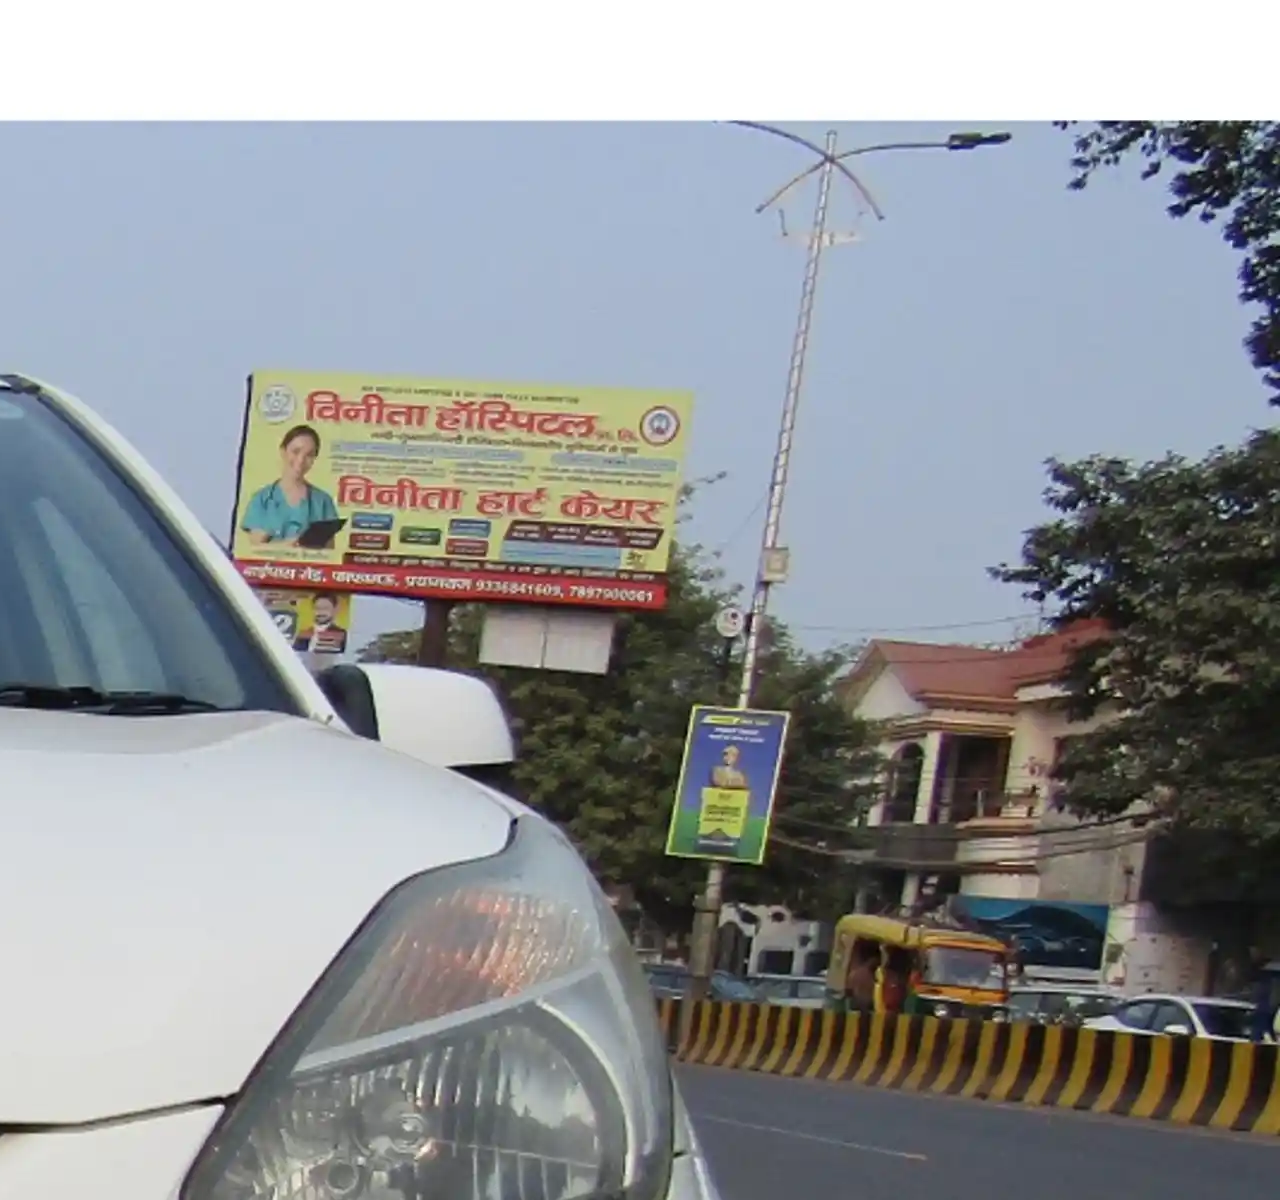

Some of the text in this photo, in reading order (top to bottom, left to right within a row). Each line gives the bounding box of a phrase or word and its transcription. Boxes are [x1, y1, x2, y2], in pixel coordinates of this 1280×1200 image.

[305, 390, 429, 427] विनीता
[434, 400, 600, 438] हॉस्पिटल
[338, 475, 666, 525] विनीता हार्ट केयर
